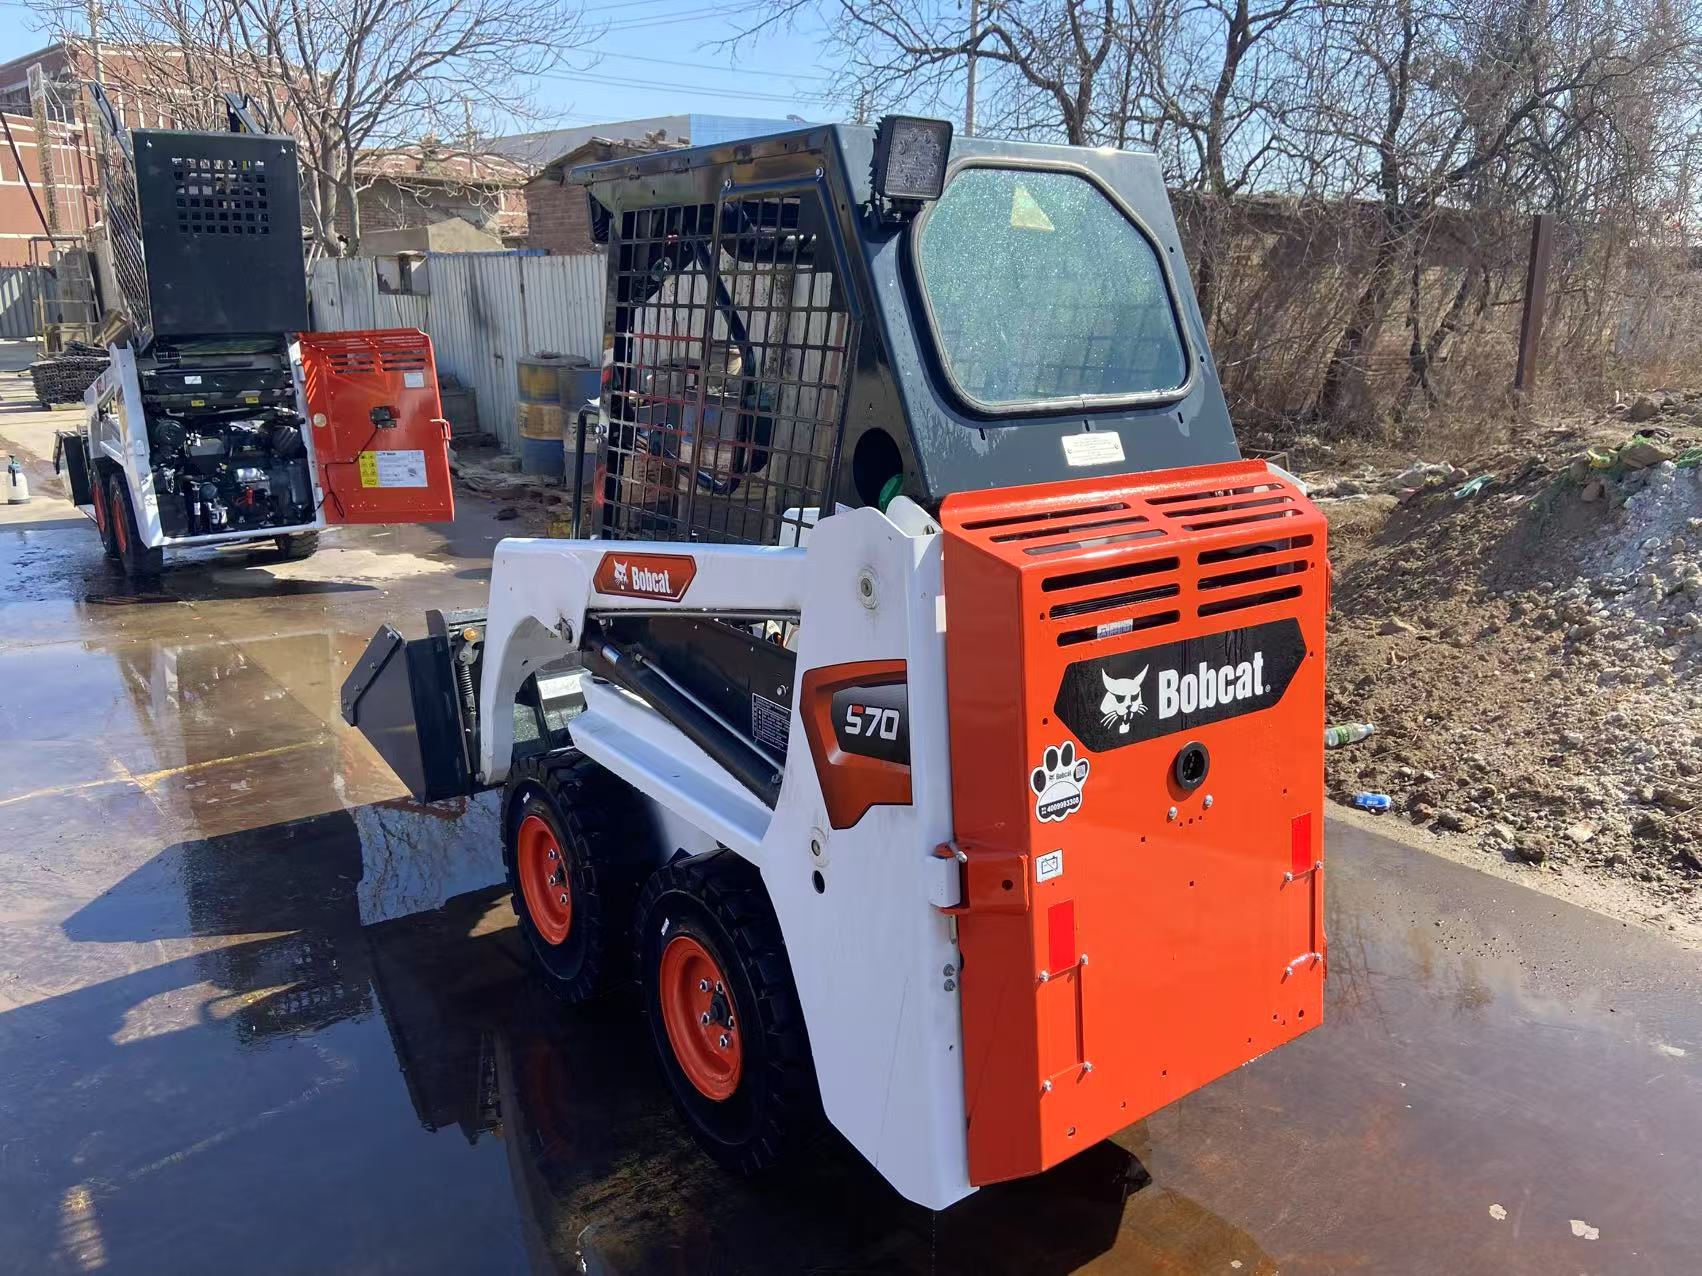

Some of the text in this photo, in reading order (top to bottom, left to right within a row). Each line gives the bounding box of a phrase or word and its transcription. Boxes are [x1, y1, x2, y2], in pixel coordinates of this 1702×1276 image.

[631, 566, 671, 594] Bobcat
[1158, 651, 1265, 720] Bobcat
[844, 704, 900, 741] S70
